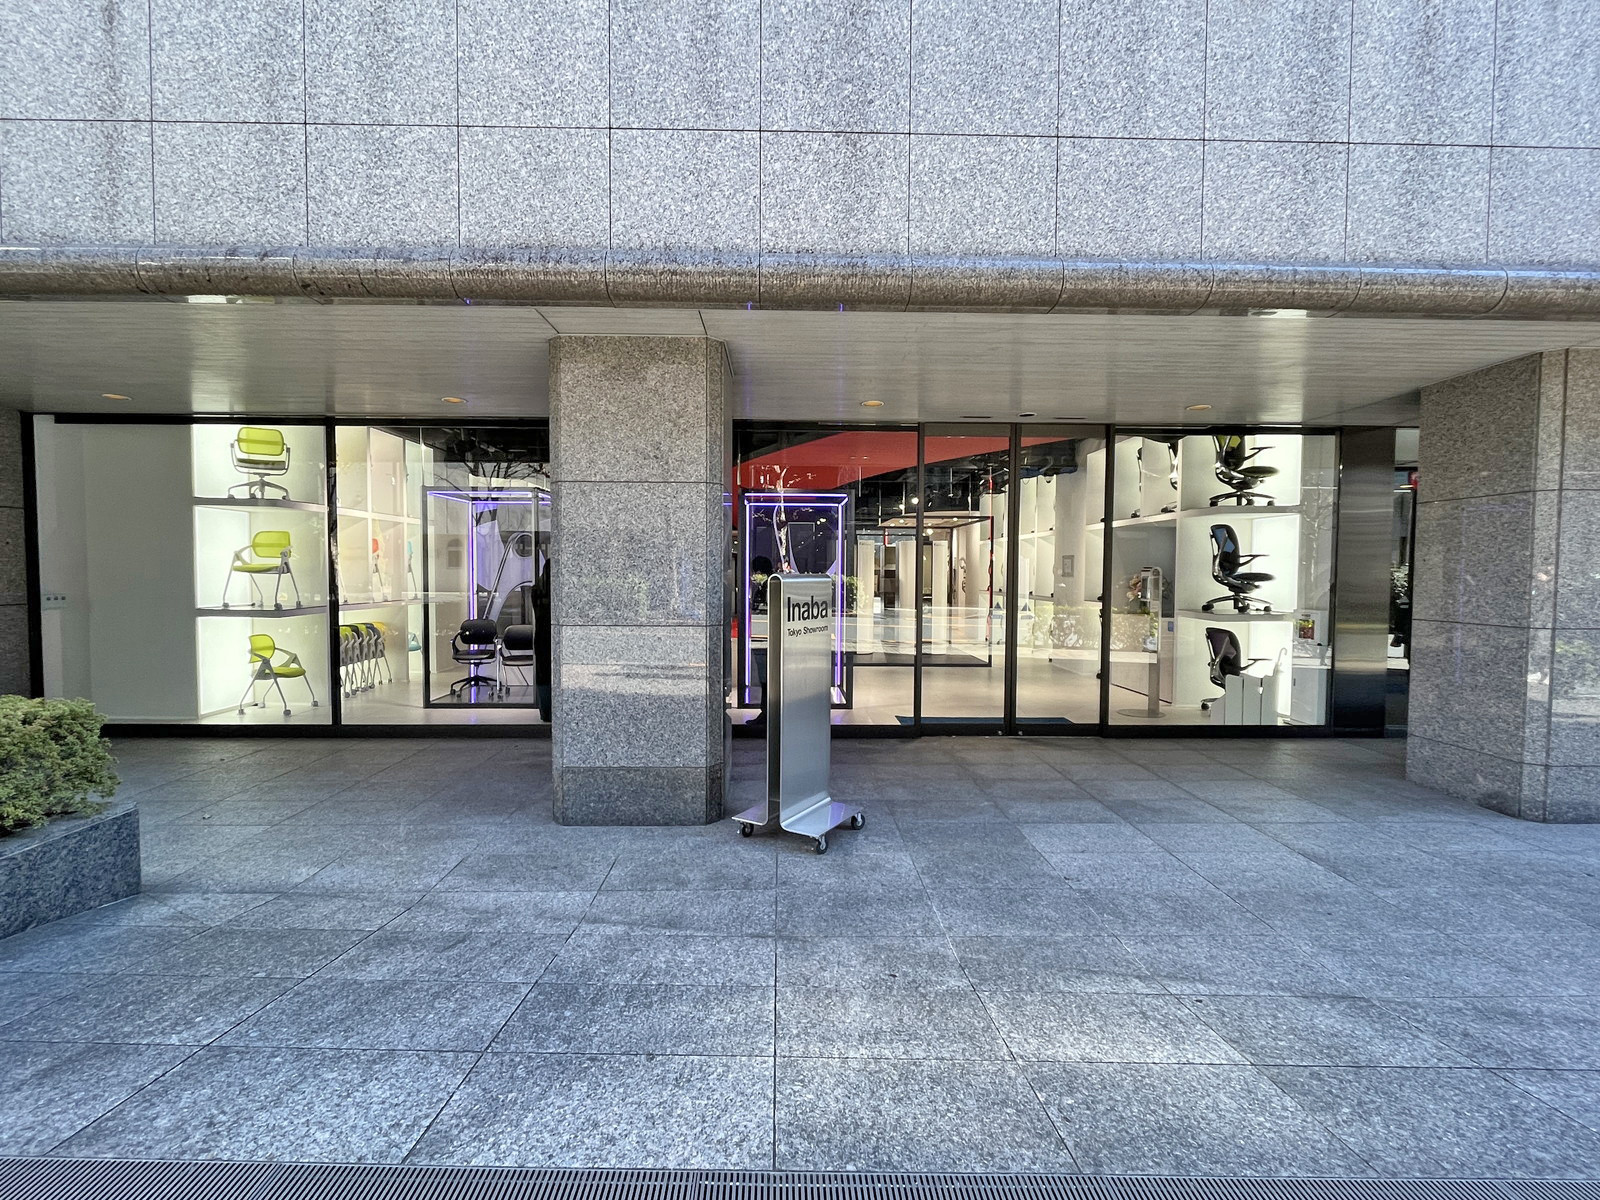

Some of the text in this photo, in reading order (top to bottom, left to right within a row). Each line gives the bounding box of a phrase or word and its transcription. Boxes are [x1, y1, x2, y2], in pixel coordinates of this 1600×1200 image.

[787, 595, 828, 622] Inaba
[787, 625, 829, 637] Tokyo Showroom
